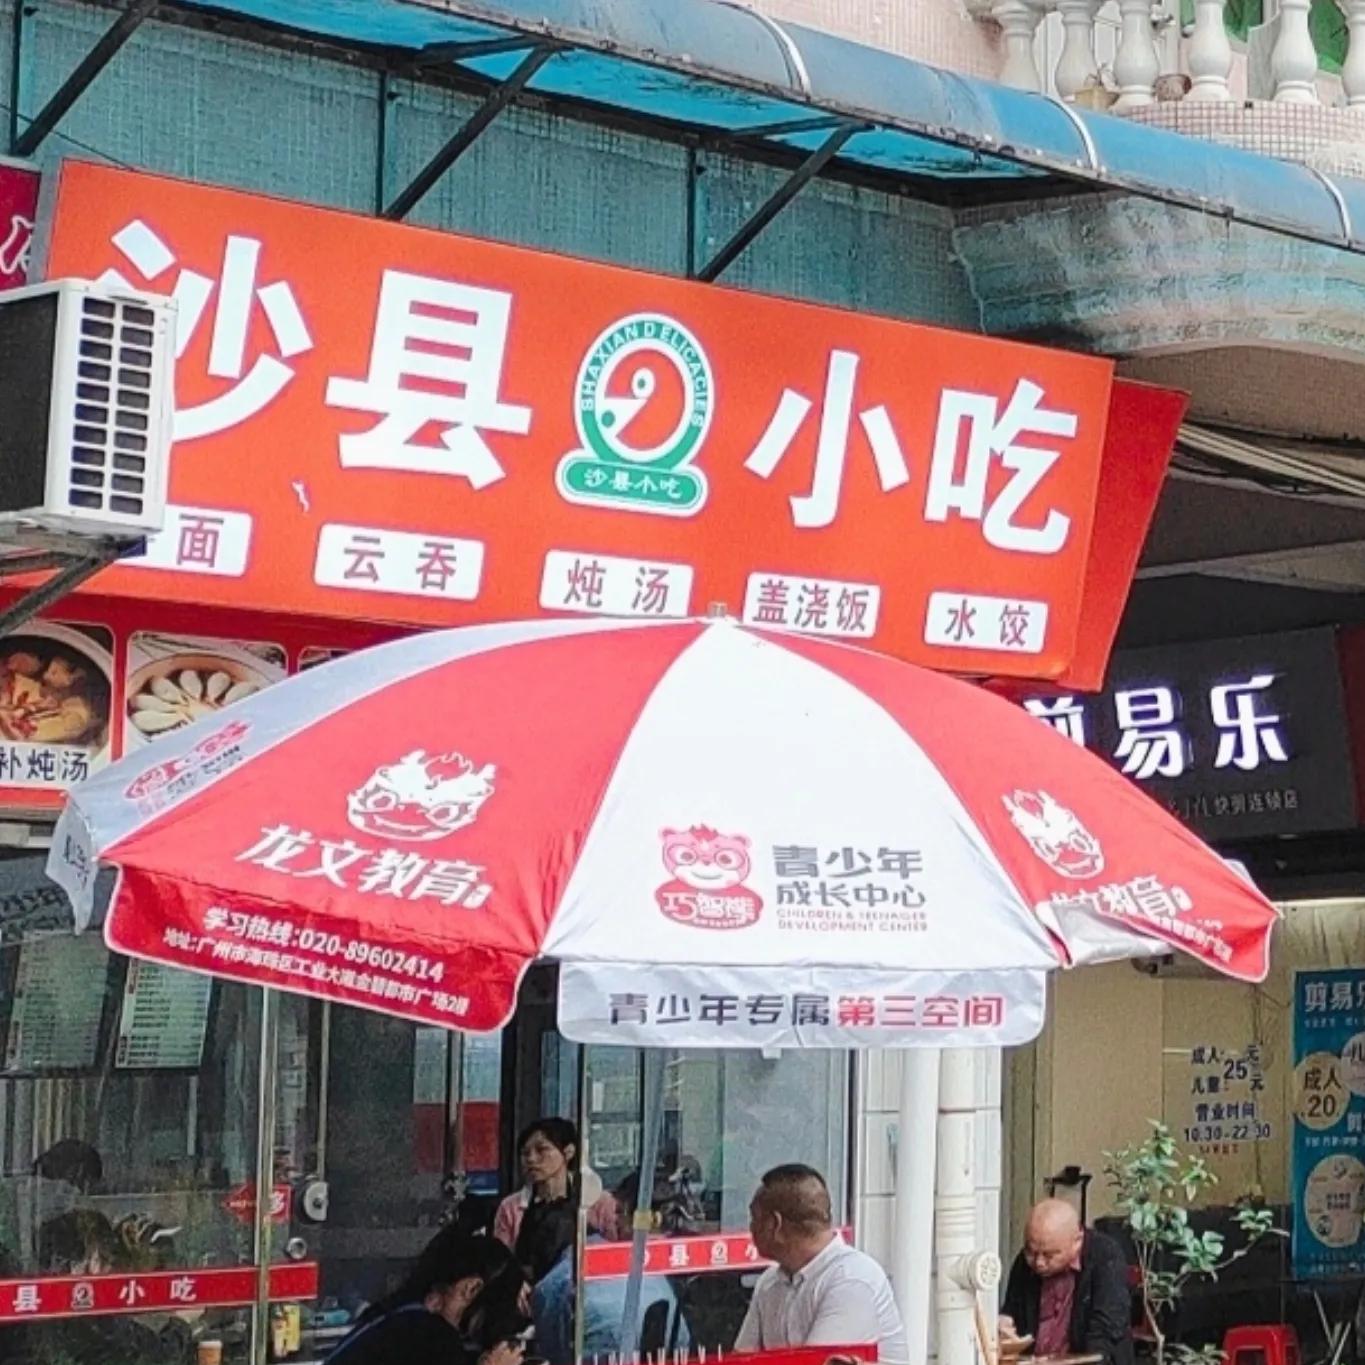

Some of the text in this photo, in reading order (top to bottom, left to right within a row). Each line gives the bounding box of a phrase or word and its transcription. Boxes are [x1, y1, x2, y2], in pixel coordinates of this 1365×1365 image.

[102, 219, 1080, 557] 沙县 小吃
[583, 467, 682, 500] 沙县小吃
[340, 533, 456, 593] 云吞
[563, 557, 671, 614] 炖汤
[752, 576, 868, 636] 盖浇饭
[941, 598, 1032, 650] 水饺
[234, 822, 483, 909] 龙文教育
[771, 845, 923, 879] 青少年
[775, 881, 927, 908] 成长中心
[608, 992, 1004, 1029] 青少年专属第三空间
[1223, 1058, 1248, 1080] 25
[1302, 1067, 1343, 1092] 成人
[1194, 1102, 1256, 1123] 营业时间
[118, 1277, 198, 1306] 小吃
